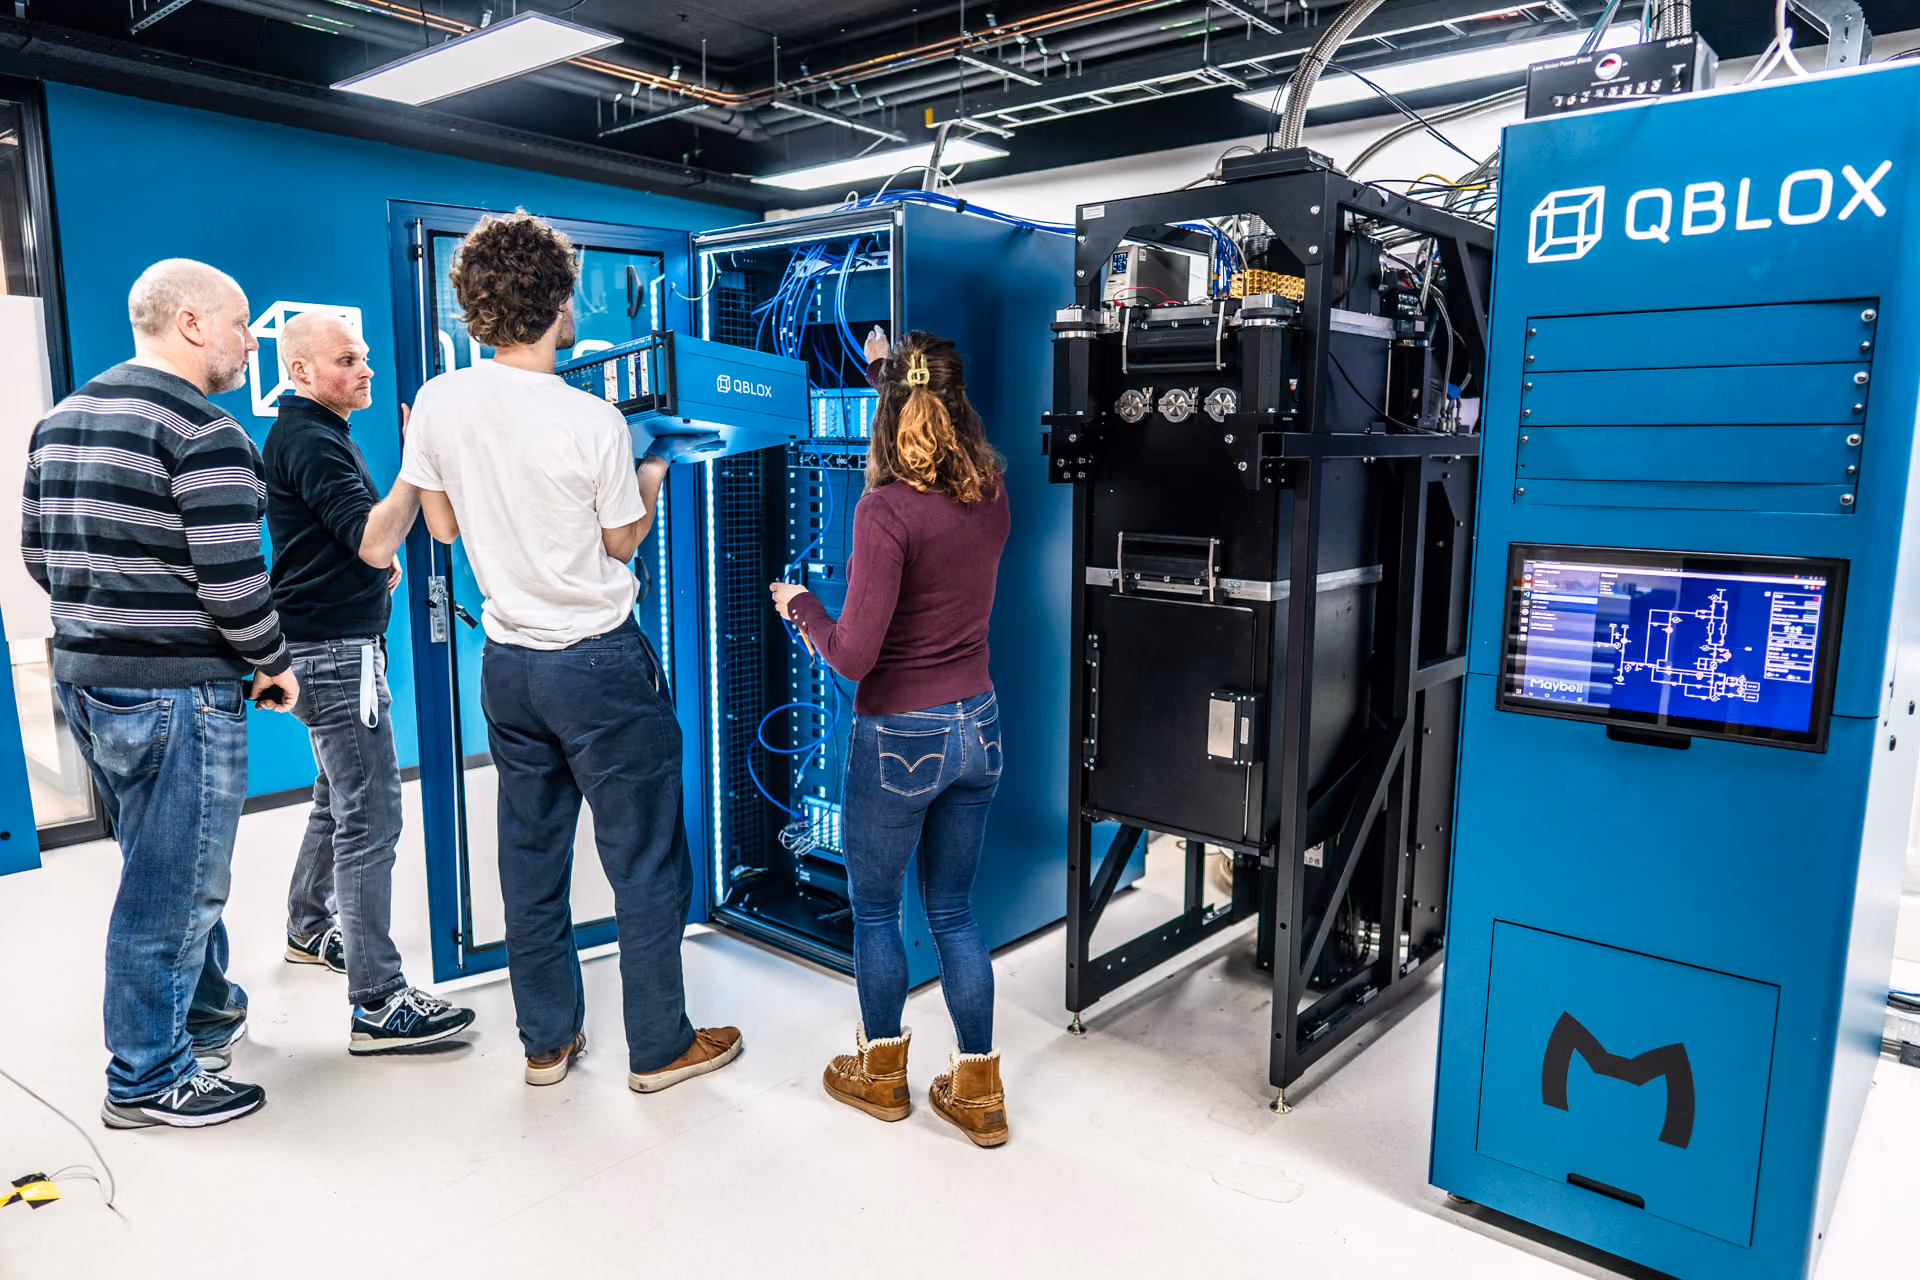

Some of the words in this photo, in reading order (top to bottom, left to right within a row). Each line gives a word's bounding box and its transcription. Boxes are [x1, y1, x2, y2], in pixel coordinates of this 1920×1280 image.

[1625, 160, 1892, 243] QBLOX
[733, 379, 773, 398] QBLOX
[1530, 678, 1583, 693] Maybell
[158, 1088, 194, 1110] N
